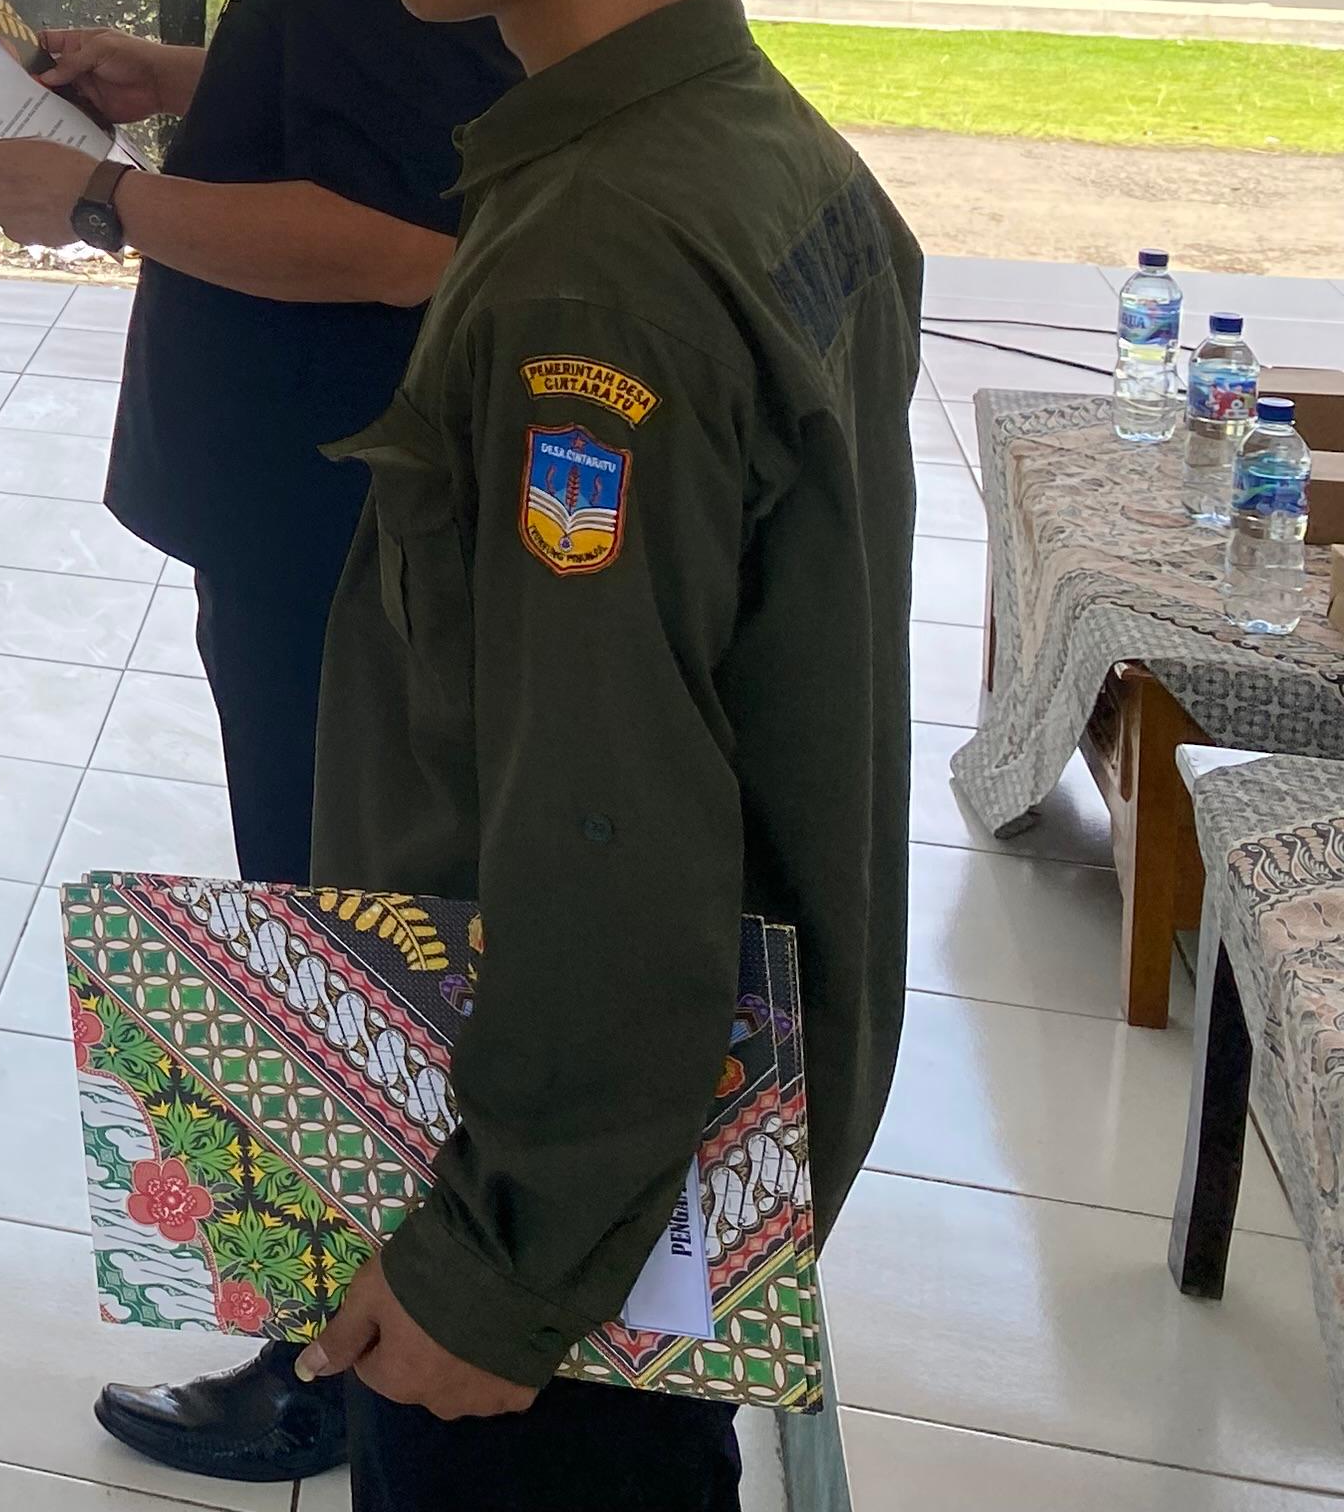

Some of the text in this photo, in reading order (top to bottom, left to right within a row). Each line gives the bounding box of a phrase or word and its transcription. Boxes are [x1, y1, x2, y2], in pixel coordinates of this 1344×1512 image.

[528, 363, 650, 410] PEMERINTAH DESA
[544, 377, 634, 411] CINTARATU
[541, 443, 616, 473] DESA CINTARATU
